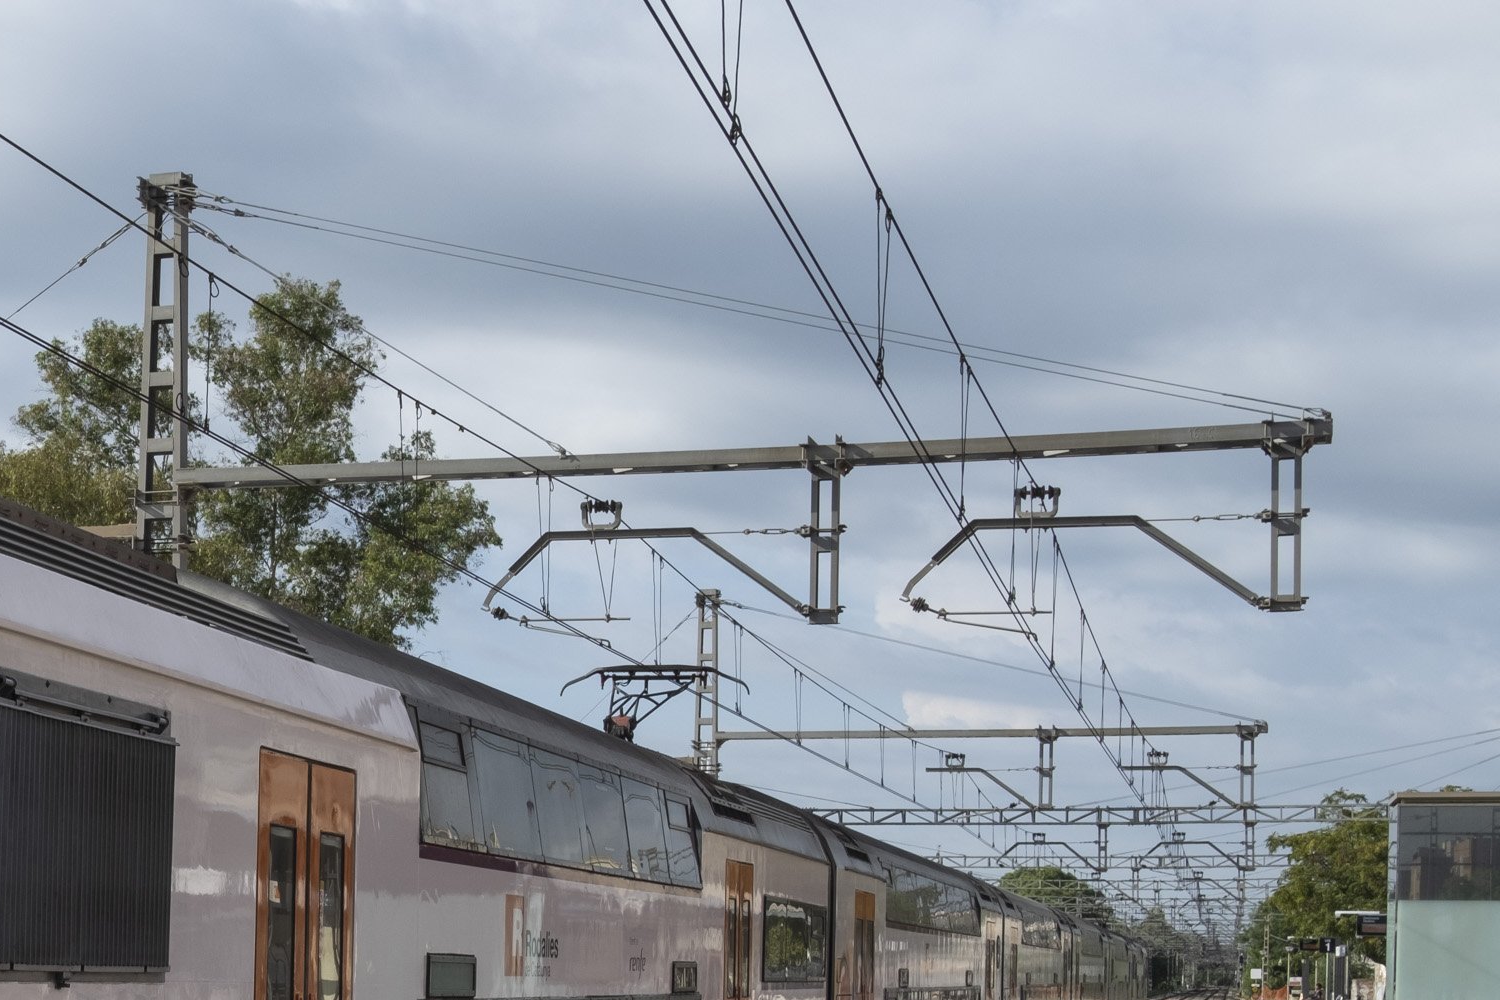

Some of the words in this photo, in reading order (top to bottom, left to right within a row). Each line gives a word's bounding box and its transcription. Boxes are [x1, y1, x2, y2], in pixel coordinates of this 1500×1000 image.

[525, 930, 559, 959] Rodalies
[1325, 943, 1330, 951] 1
[629, 947, 646, 980] renfe
